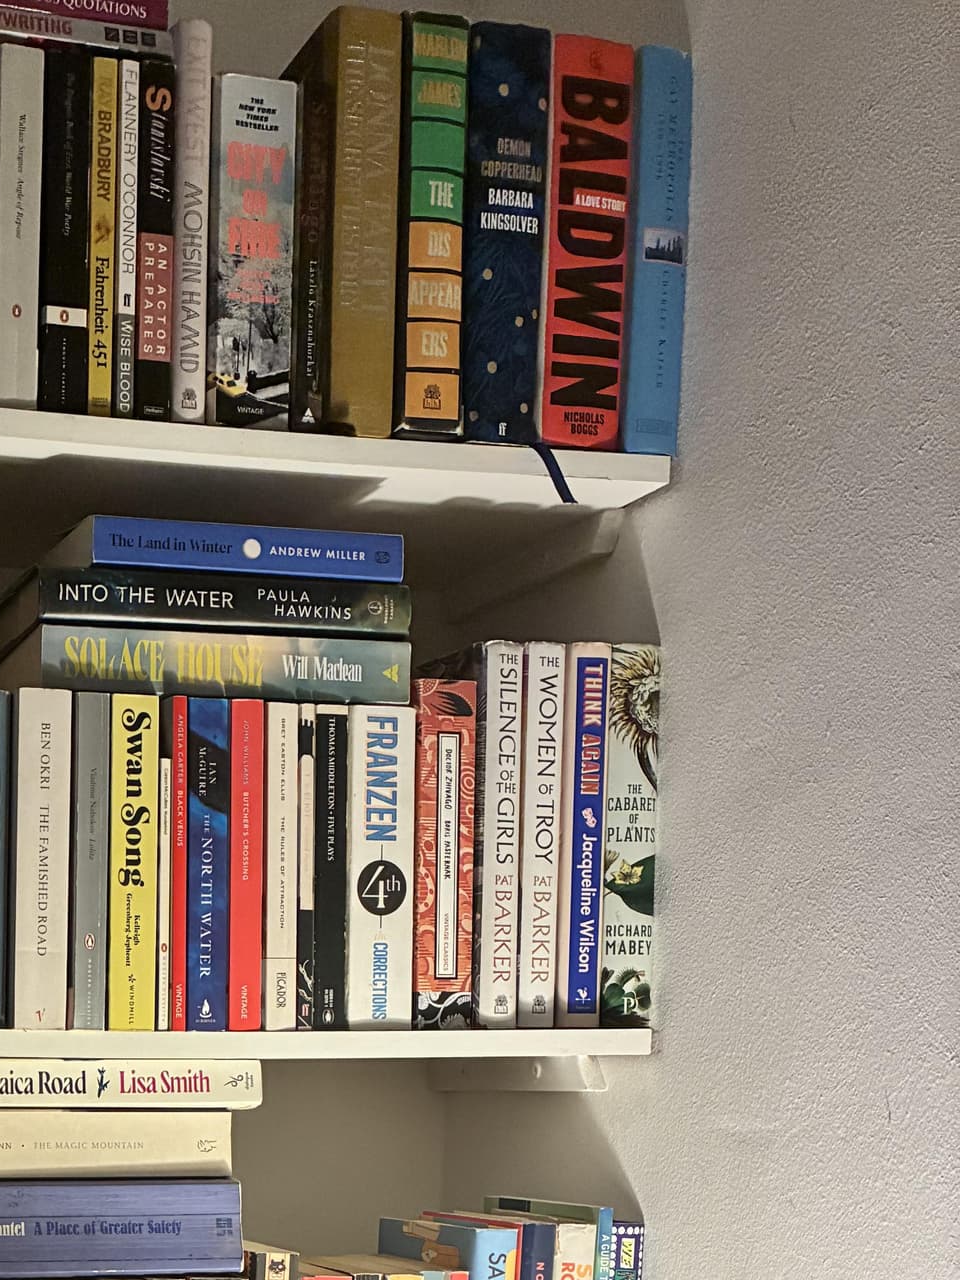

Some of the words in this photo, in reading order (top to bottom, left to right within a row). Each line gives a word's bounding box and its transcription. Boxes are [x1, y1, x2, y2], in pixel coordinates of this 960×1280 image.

[96, 110, 112, 202] BRADBURY
[496, 138, 532, 158] DEMON
[480, 160, 542, 184] COPPERHEAD
[487, 187, 535, 210] BARBARA
[575, 194, 582, 206] A
[583, 194, 602, 209] LOVE
[602, 196, 627, 213] STORY
[182, 181, 205, 284] MOHSIN
[479, 212, 539, 235] KINGSOLVER
[549, 74, 630, 411] BALDWIN
[92, 256, 110, 335] Fahrenheit
[179, 287, 202, 374] HAMID
[93, 340, 107, 368] 451
[563, 411, 605, 426] NICHOLAS
[570, 423, 599, 437] BOGGS
[269, 545, 322, 560] ANDREW
[325, 548, 367, 562] MILLER
[58, 583, 109, 602] INTO
[115, 585, 155, 604] THE
[165, 589, 234, 609] WATER
[257, 588, 311, 603] PAULA
[274, 603, 352, 620] HAWKINS
[539, 655, 560, 668] THE
[582, 663, 603, 727] THINK
[41, 722, 51, 748] BEN
[537, 674, 559, 779] WOMEN
[121, 708, 152, 799] Swan
[580, 733, 601, 796] AGAIN
[40, 753, 50, 791] OKRI
[365, 715, 399, 842] FRANZEN
[538, 783, 554, 795] OF
[627, 784, 642, 794] THE
[40, 804, 49, 829] THE
[607, 797, 656, 812] CABARET
[534, 798, 555, 865] TROY
[628, 813, 639, 825] OF
[117, 803, 151, 888] Song
[606, 826, 655, 843] PLANTS
[38, 832, 49, 911] FAMISHED
[532, 875, 553, 887] PAT
[581, 833, 598, 916] Jacqueline
[36, 914, 48, 957] ROAD
[530, 891, 550, 985] BARKER
[605, 925, 652, 938] RICHARD
[577, 918, 596, 973] Wilson
[605, 940, 652, 956] MABEY
[371, 941, 388, 1020] CORRECTIONS
[38, 1070, 87, 1095] Road
[119, 1070, 157, 1095] Lisa
[160, 1069, 211, 1094] Smith
